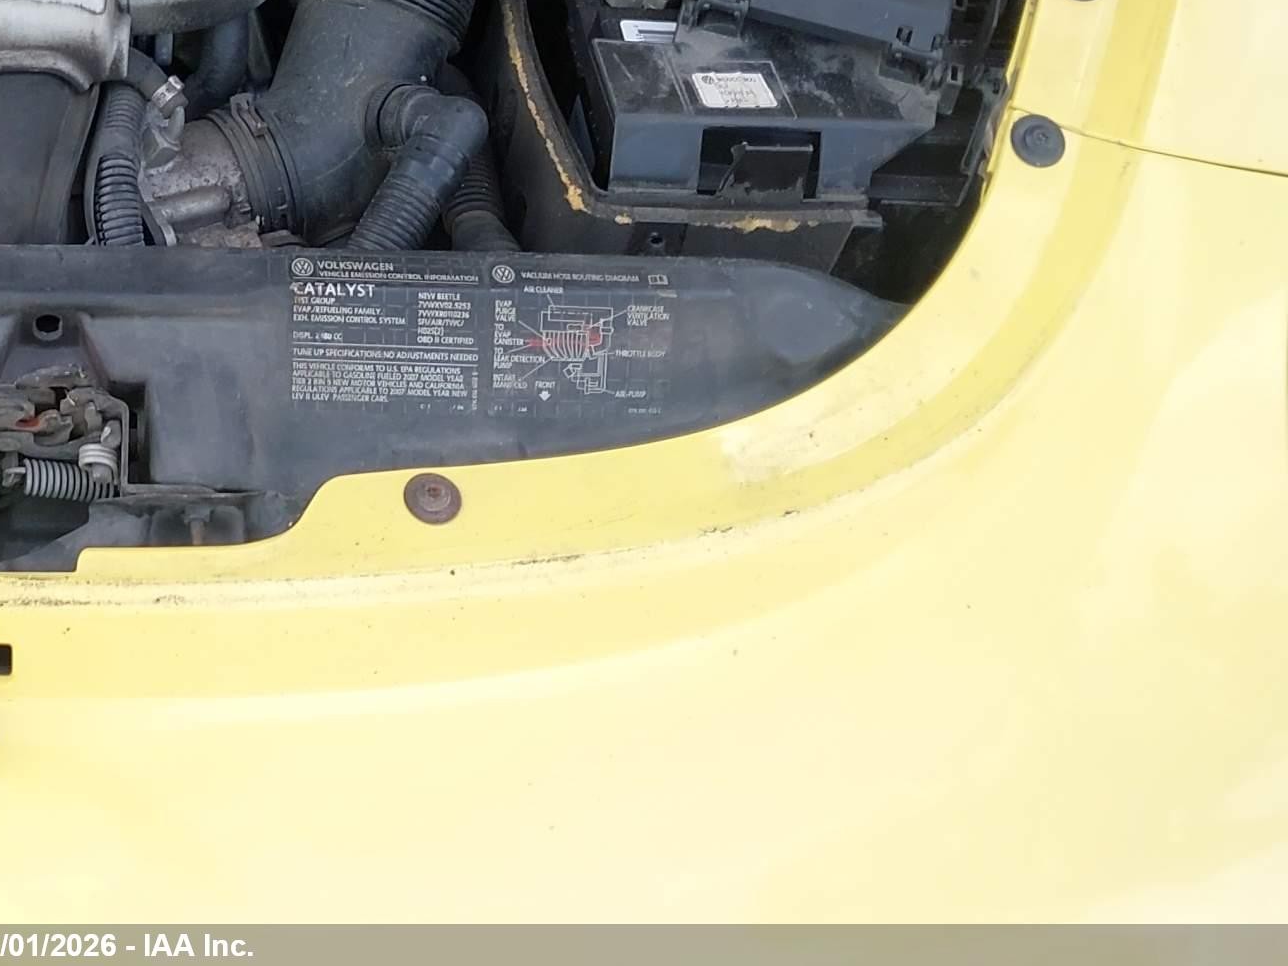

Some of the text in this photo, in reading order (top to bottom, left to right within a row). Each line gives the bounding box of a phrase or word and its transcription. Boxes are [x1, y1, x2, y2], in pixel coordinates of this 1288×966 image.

[317, 260, 393, 271] VOLKSWAGEN
[424, 274, 478, 282] INFORMATION
[520, 271, 640, 282] VACUUM HOSE ROUTING DIAGRAM
[294, 282, 375, 298] CATALYST
[523, 285, 564, 294] AIR CLEANER
[311, 297, 336, 305] GROUP
[418, 292, 461, 301] NEW BEETLE
[495, 307, 516, 315] PURGE
[626, 305, 664, 313] CRANKCASE
[311, 314, 344, 323] EMISSION
[346, 315, 377, 324] CONTROL
[379, 316, 406, 325] SYSTEM
[495, 314, 516, 322] VALVE
[627, 312, 670, 320] VENTILATION
[494, 323, 504, 331] TO
[626, 319, 648, 327] VALVE
[417, 335, 433, 344] OBD
[441, 336, 474, 345] CERTIFIED
[494, 337, 524, 346] CANISTER
[293, 347, 312, 355] TUNE
[313, 348, 324, 356] UP
[383, 350, 394, 359] NO
[396, 351, 448, 361] ADJUSTMENTS
[450, 353, 478, 362] NEEDED
[494, 347, 503, 355] TO
[615, 349, 666, 358] THROTTLE BODY
[493, 354, 545, 363] LEAK DETECTION
[293, 362, 307, 370] THIS
[310, 362, 335, 370] VEHICLE
[414, 366, 461, 375] REGULATIONS
[493, 361, 512, 369] PUMP
[292, 370, 330, 378] APPLICABLE
[343, 371, 376, 380] GASOLINE
[377, 372, 401, 380] FUELED
[420, 374, 444, 382] MODEL
[292, 377, 306, 385] TIER
[350, 379, 375, 387] MOTOR
[377, 380, 407, 388] VEHICLES
[424, 381, 464, 389] CALIFORNIA
[535, 380, 555, 389] FRONT
[292, 385, 337, 393] REGULATIONS
[407, 388, 431, 396] MODEL
[433, 389, 449, 397] YEAR
[312, 393, 329, 401] ULEV
[332, 394, 370, 402] PASSENGER
